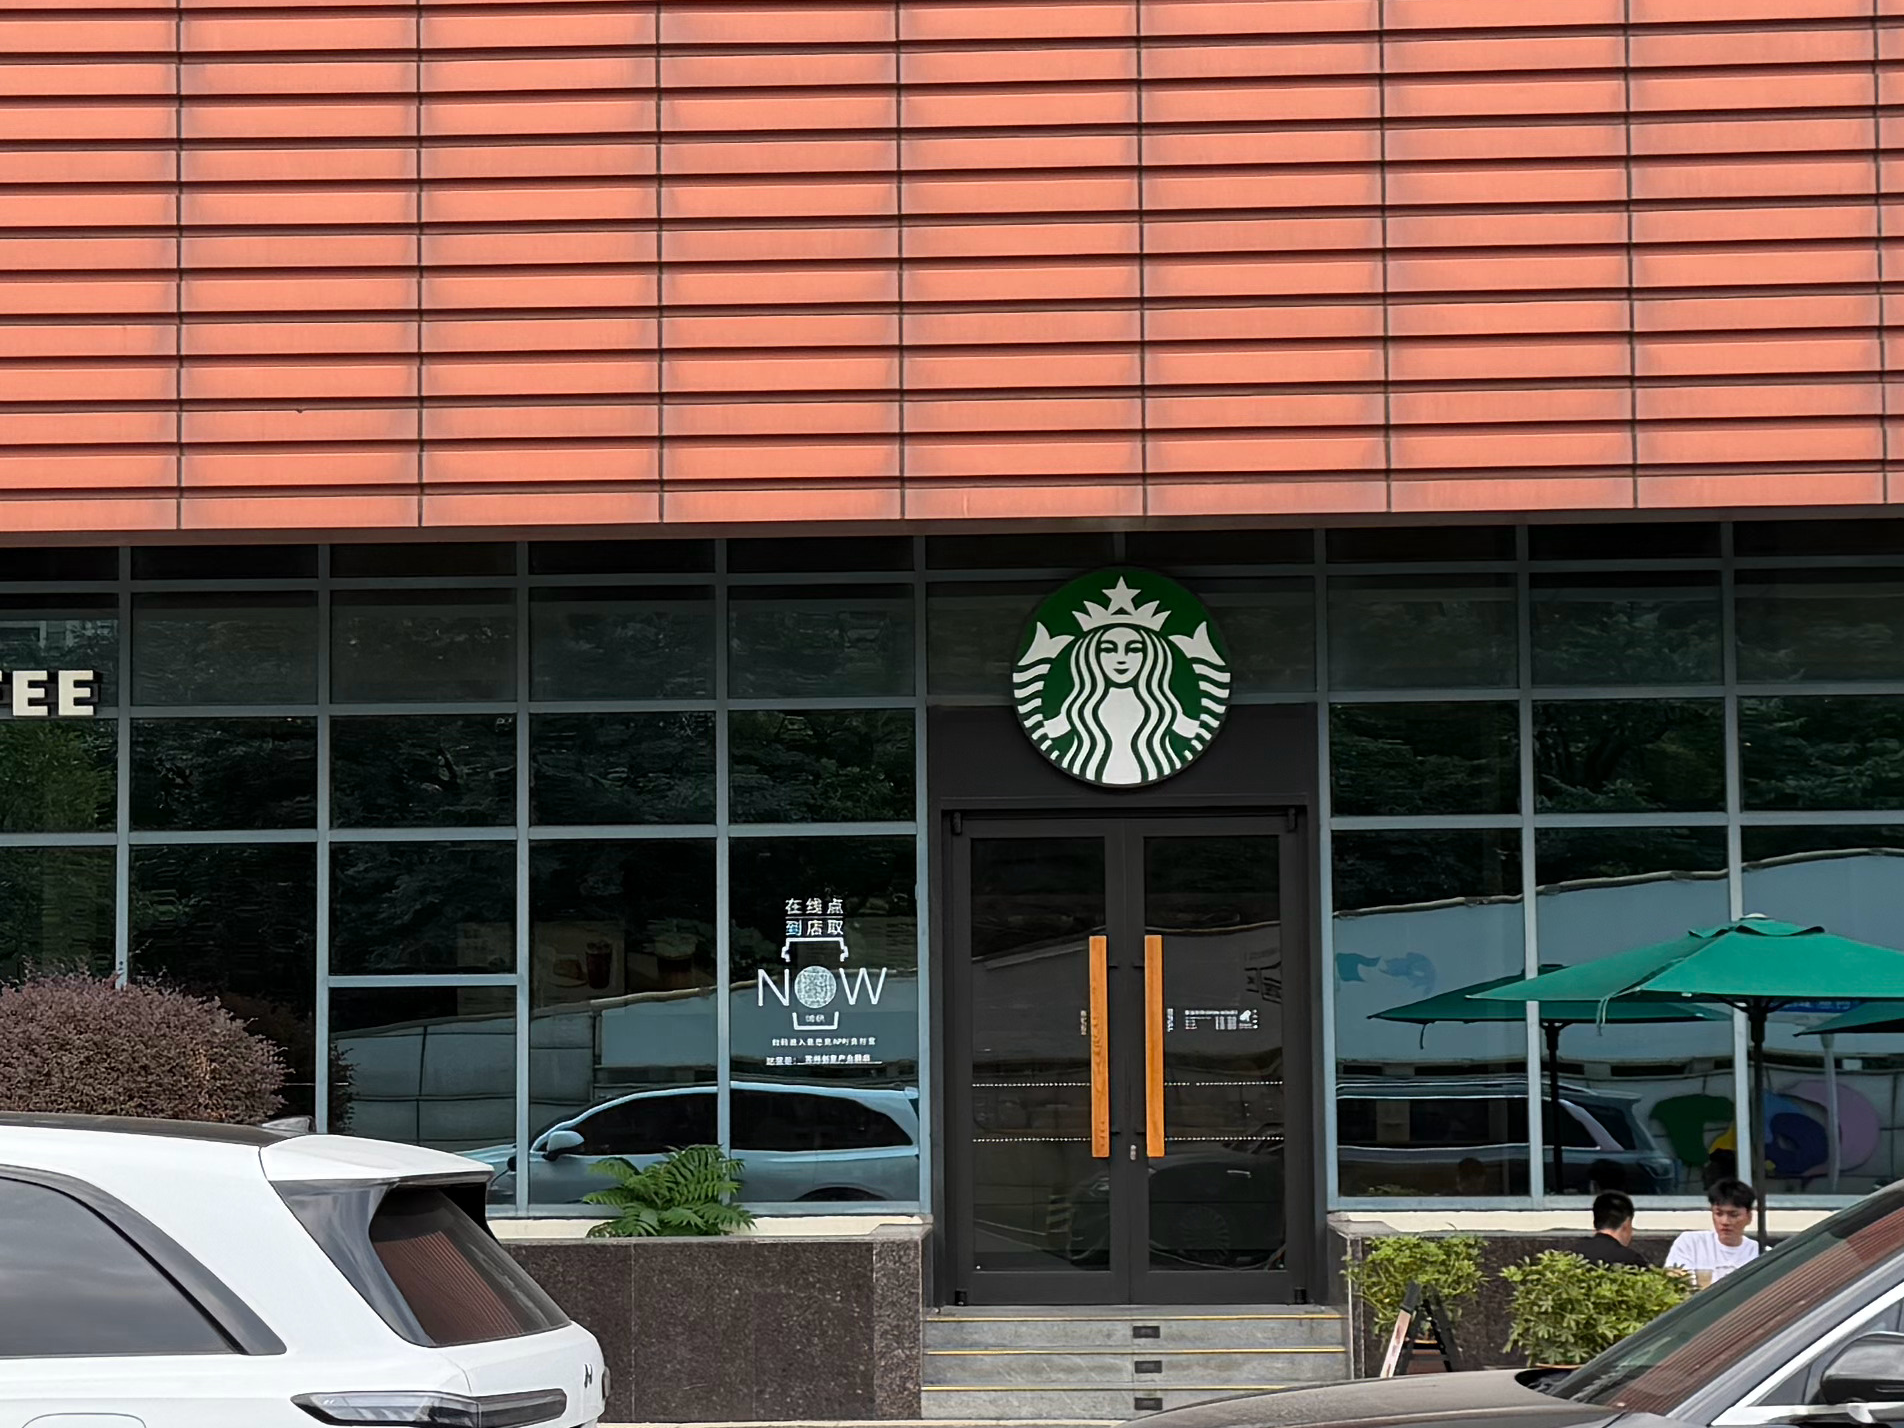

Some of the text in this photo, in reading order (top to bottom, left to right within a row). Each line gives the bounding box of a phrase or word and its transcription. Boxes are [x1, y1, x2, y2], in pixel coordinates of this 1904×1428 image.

[785, 897, 843, 914] 在线点
[786, 919, 843, 936] 到店取
